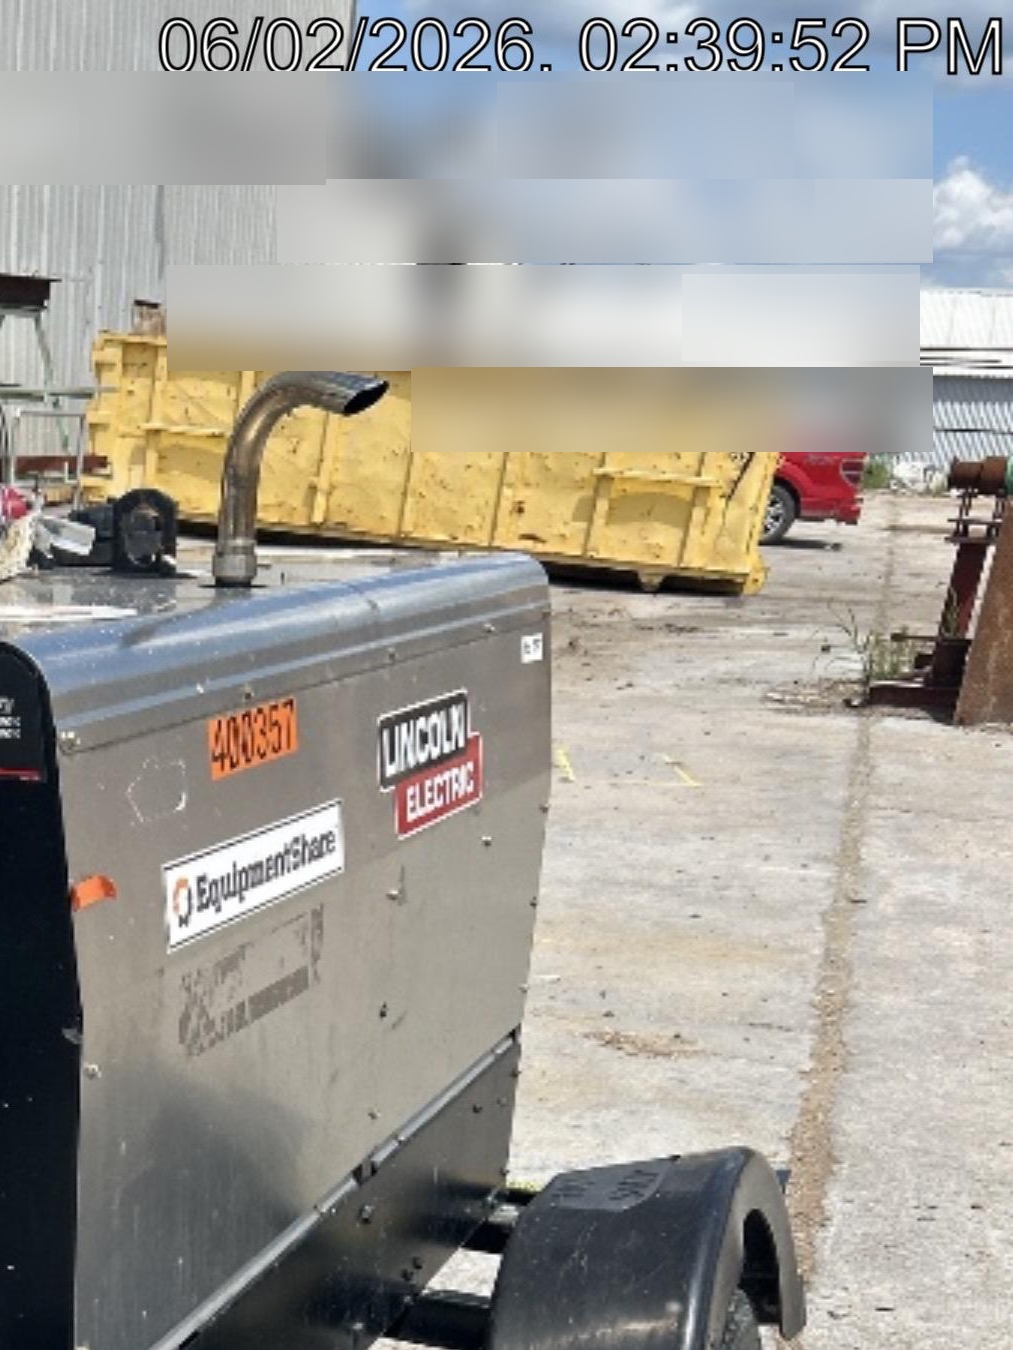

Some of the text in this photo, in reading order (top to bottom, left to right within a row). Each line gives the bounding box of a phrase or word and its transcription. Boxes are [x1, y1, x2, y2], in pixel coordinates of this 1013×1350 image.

[211, 699, 295, 772] 400357
[382, 703, 465, 777] LINCOLN
[406, 762, 474, 823] ELECTRIC
[196, 827, 336, 913] EquipmentShare
